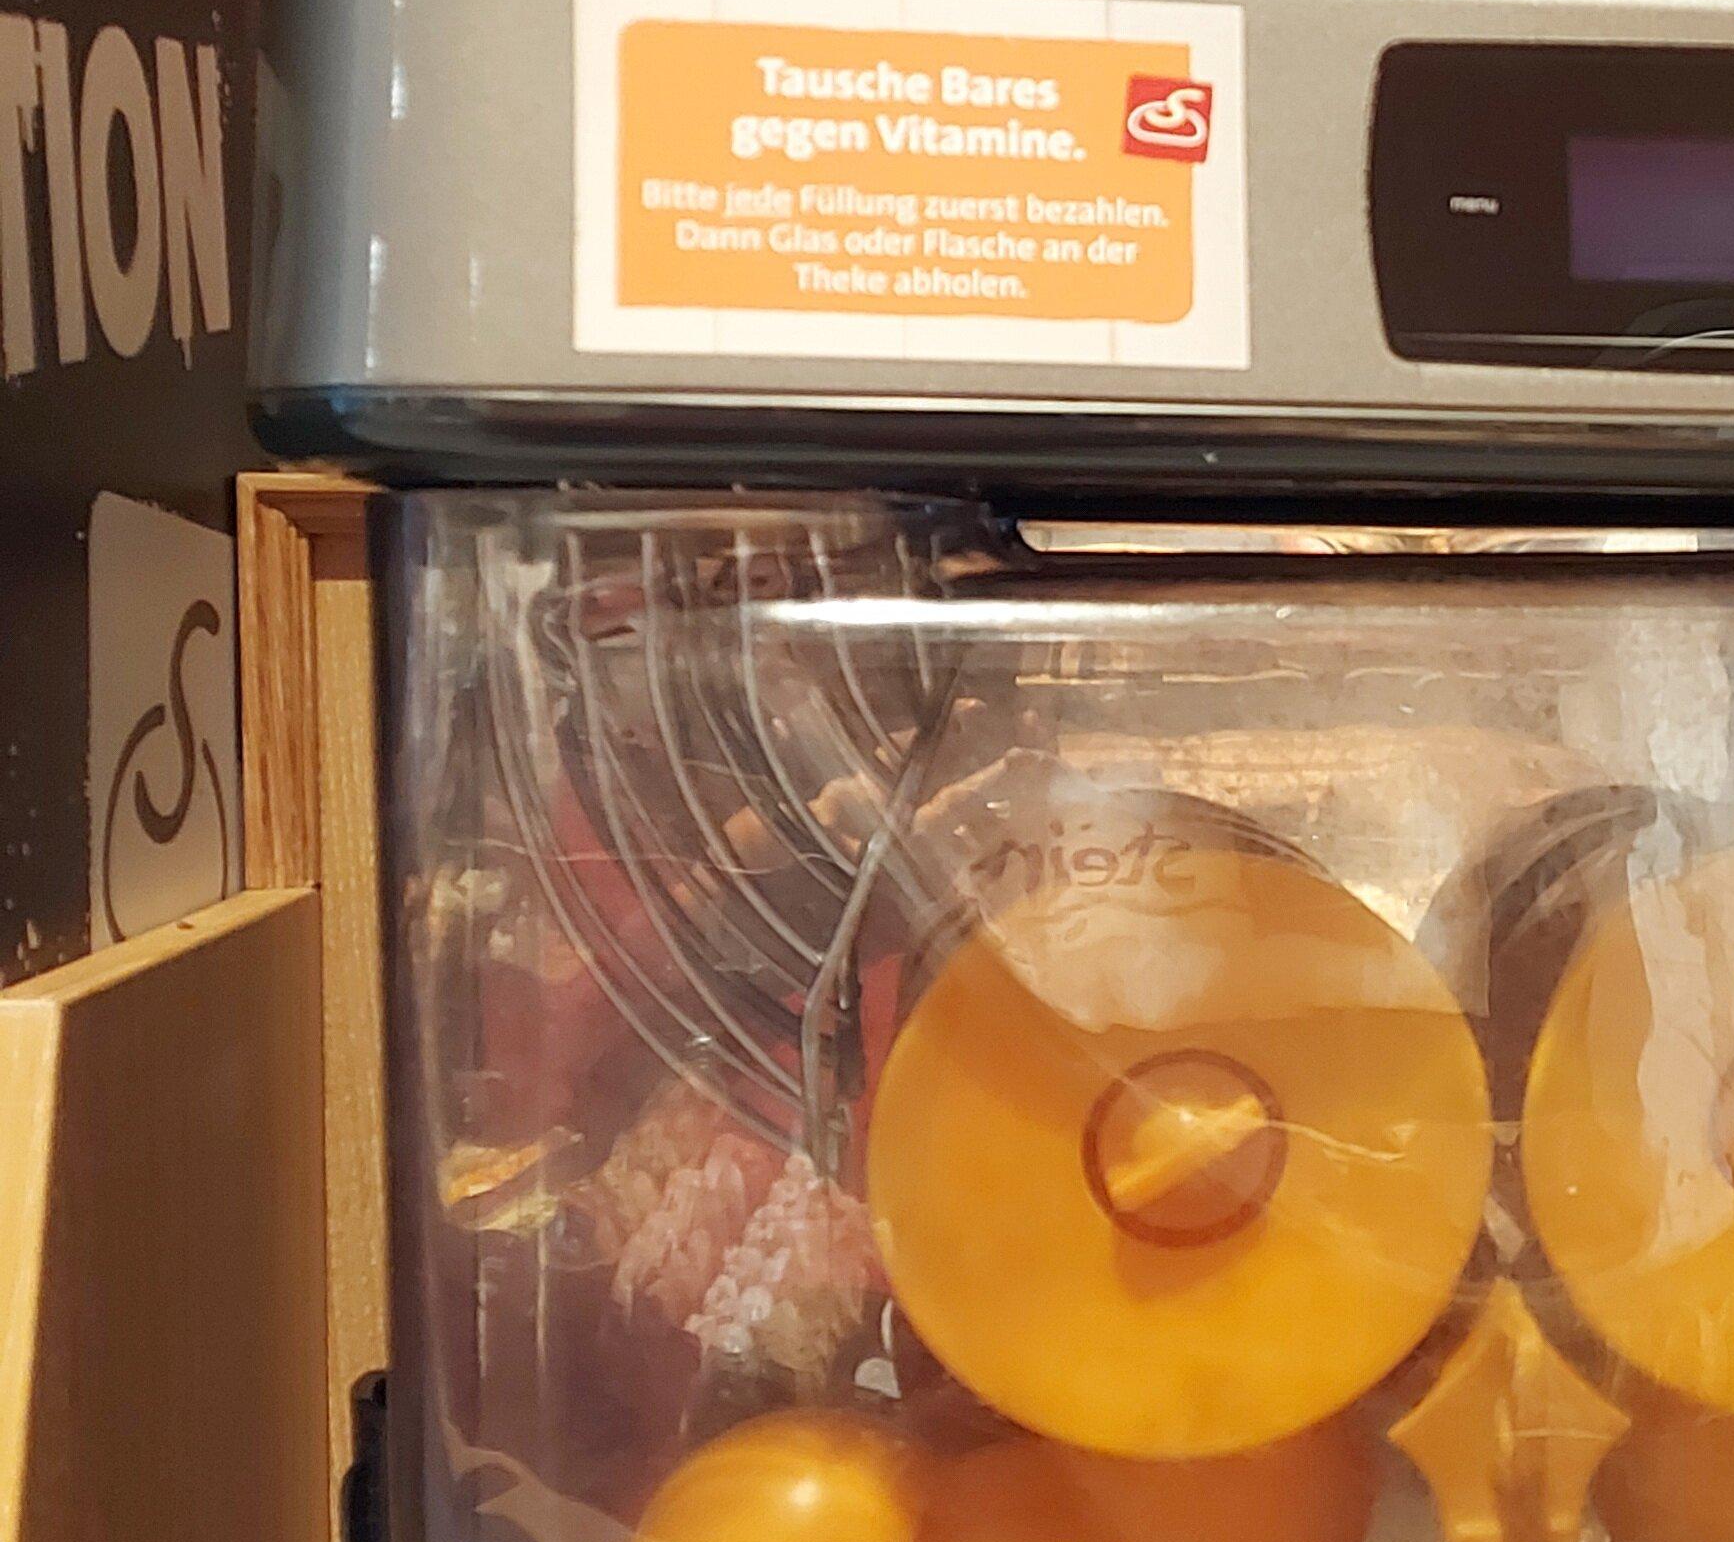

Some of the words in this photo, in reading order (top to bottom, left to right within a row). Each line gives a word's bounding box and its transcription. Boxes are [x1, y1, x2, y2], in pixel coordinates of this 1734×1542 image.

[757, 58, 929, 104] Tausche
[941, 67, 1059, 110] Bares
[730, 117, 867, 160] gegen
[876, 115, 1086, 162] Vitamine.
[641, 180, 716, 210] Bitte
[725, 185, 790, 218] jede
[800, 186, 916, 225] Füllung
[925, 195, 1018, 222] zuerst
[1027, 195, 1170, 228] bezahlen.
[675, 221, 759, 254] Dann
[768, 224, 838, 256] Glas
[845, 228, 915, 258] oder
[923, 231, 1034, 261] Flasche
[1042, 241, 1079, 262] an
[1086, 235, 1138, 264] der
[794, 264, 884, 293] Theke
[893, 267, 1029, 299] abholen.
